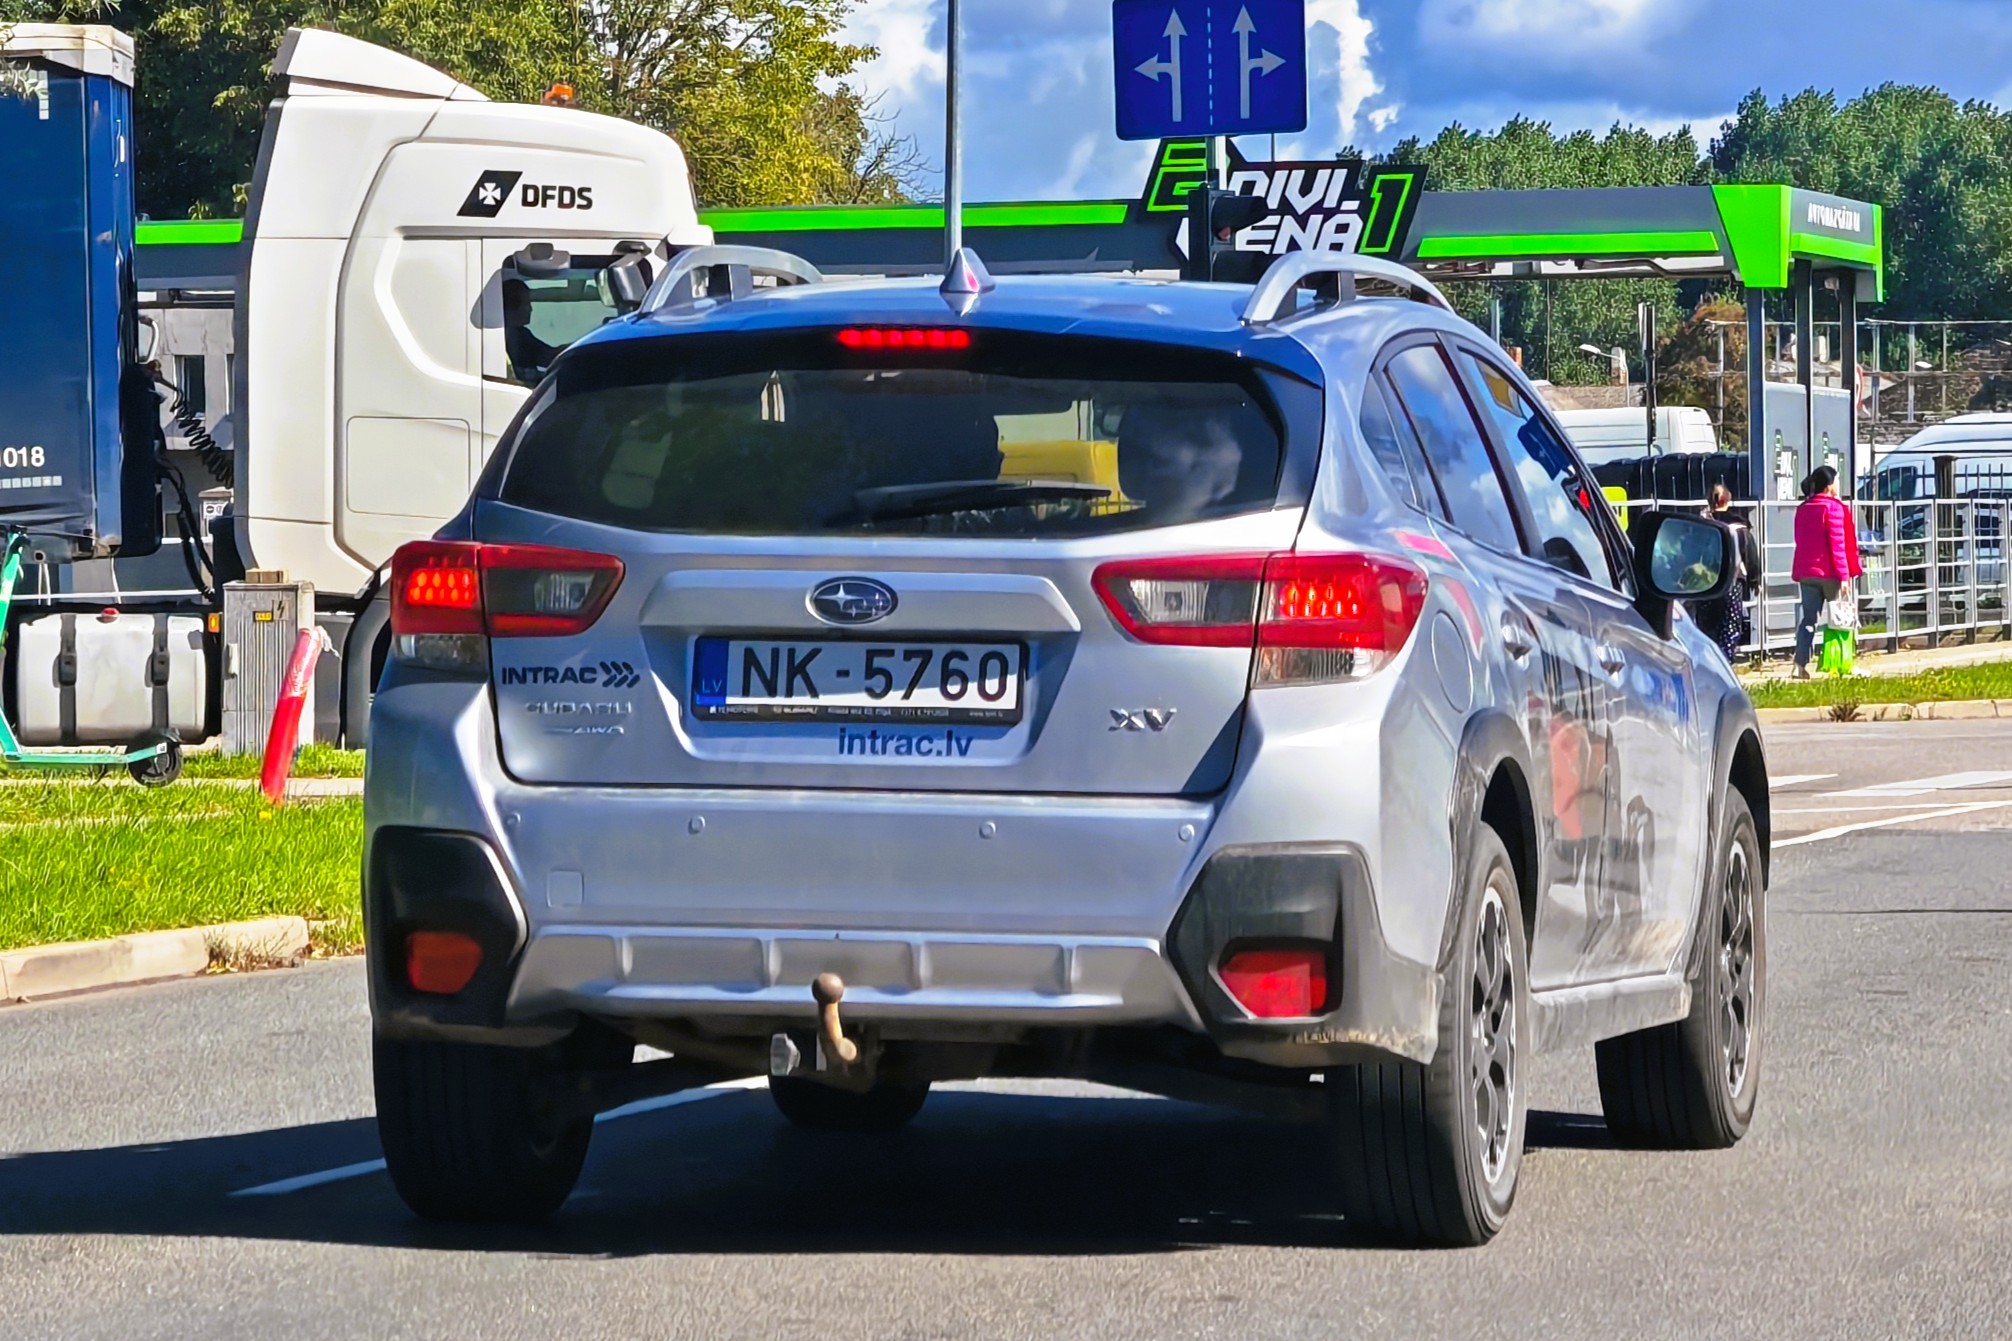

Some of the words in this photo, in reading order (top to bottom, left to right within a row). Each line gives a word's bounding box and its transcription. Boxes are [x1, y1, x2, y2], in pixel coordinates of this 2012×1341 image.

[521, 183, 593, 210] DFDS
[1358, 173, 1414, 253] 1
[0, 446, 46, 467] 018
[501, 665, 598, 685] INTRAC
[702, 679, 723, 693] LV
[1108, 708, 1177, 732] XV
[838, 727, 974, 757] intrac.lv
